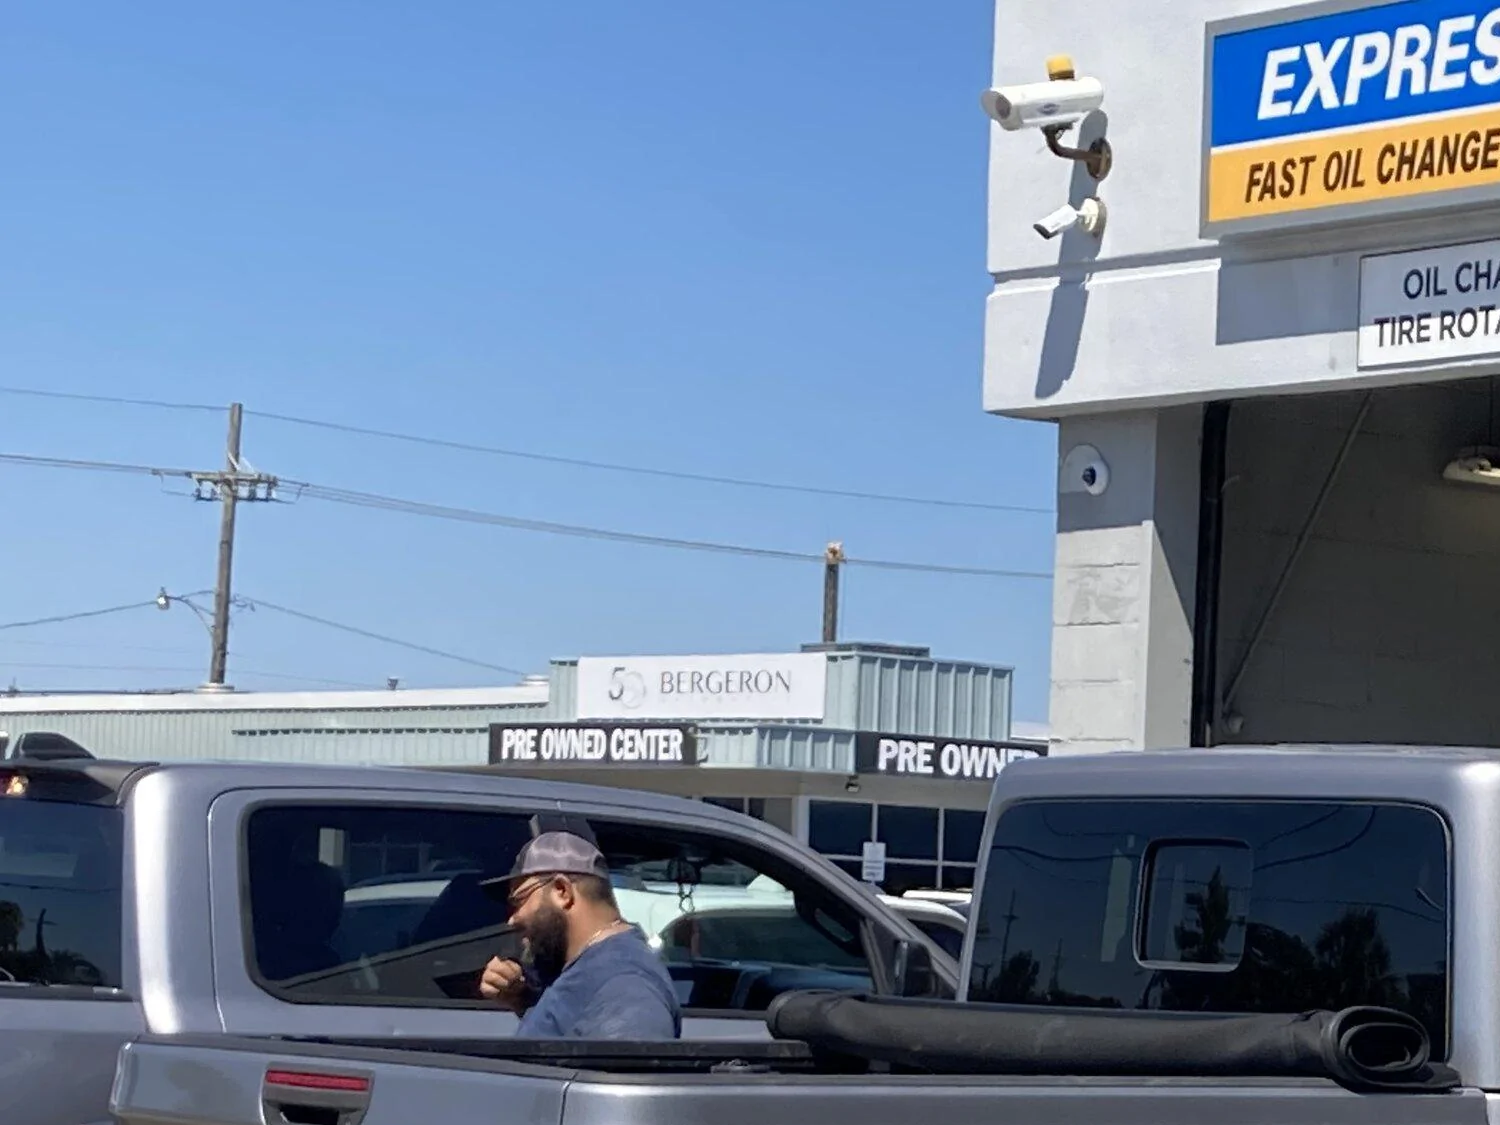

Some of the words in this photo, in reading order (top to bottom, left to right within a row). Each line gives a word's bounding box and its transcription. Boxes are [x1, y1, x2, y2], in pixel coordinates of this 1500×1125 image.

[1245, 155, 1317, 203] FAST
[1323, 148, 1366, 192] OIL
[1403, 266, 1448, 299] OIL
[1373, 312, 1433, 347] TIRE
[660, 669, 791, 694] BERGERON
[501, 728, 537, 761] PRE
[540, 728, 607, 761] OWNED
[610, 728, 684, 761] CENTER
[878, 739, 935, 773] PRE
